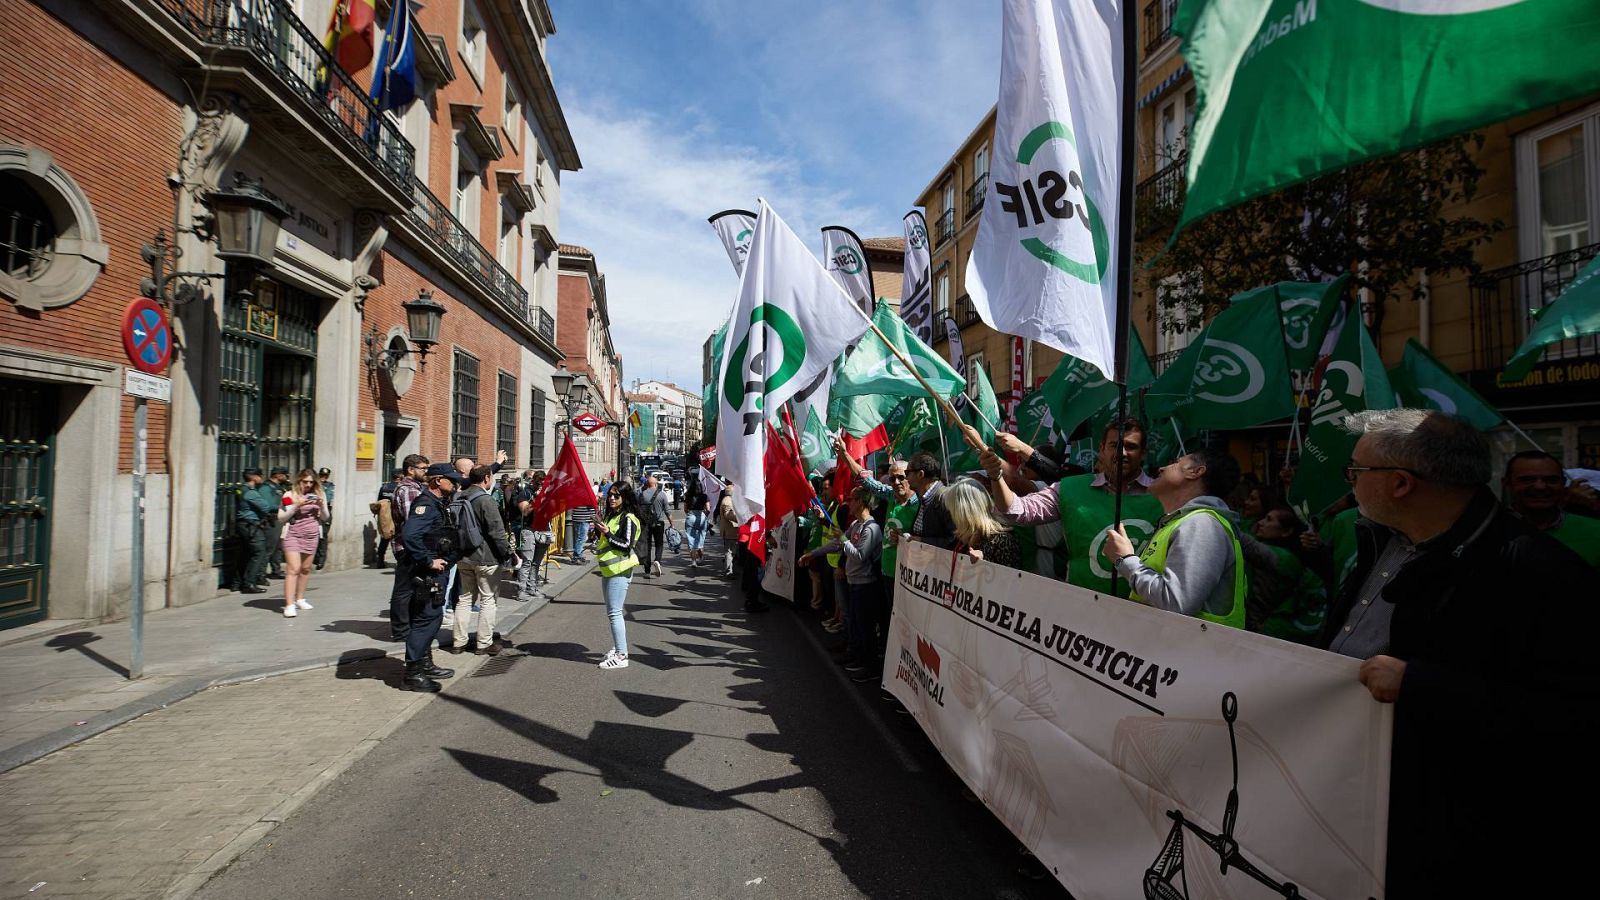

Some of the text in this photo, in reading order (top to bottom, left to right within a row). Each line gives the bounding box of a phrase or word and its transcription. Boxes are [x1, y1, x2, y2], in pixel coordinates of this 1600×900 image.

[1547, 365, 1565, 385] de
[914, 571, 929, 593] LA
[984, 599, 1016, 631] DE
[1013, 610, 1042, 645] LA
[900, 645, 945, 708] INTERSINDICAL
